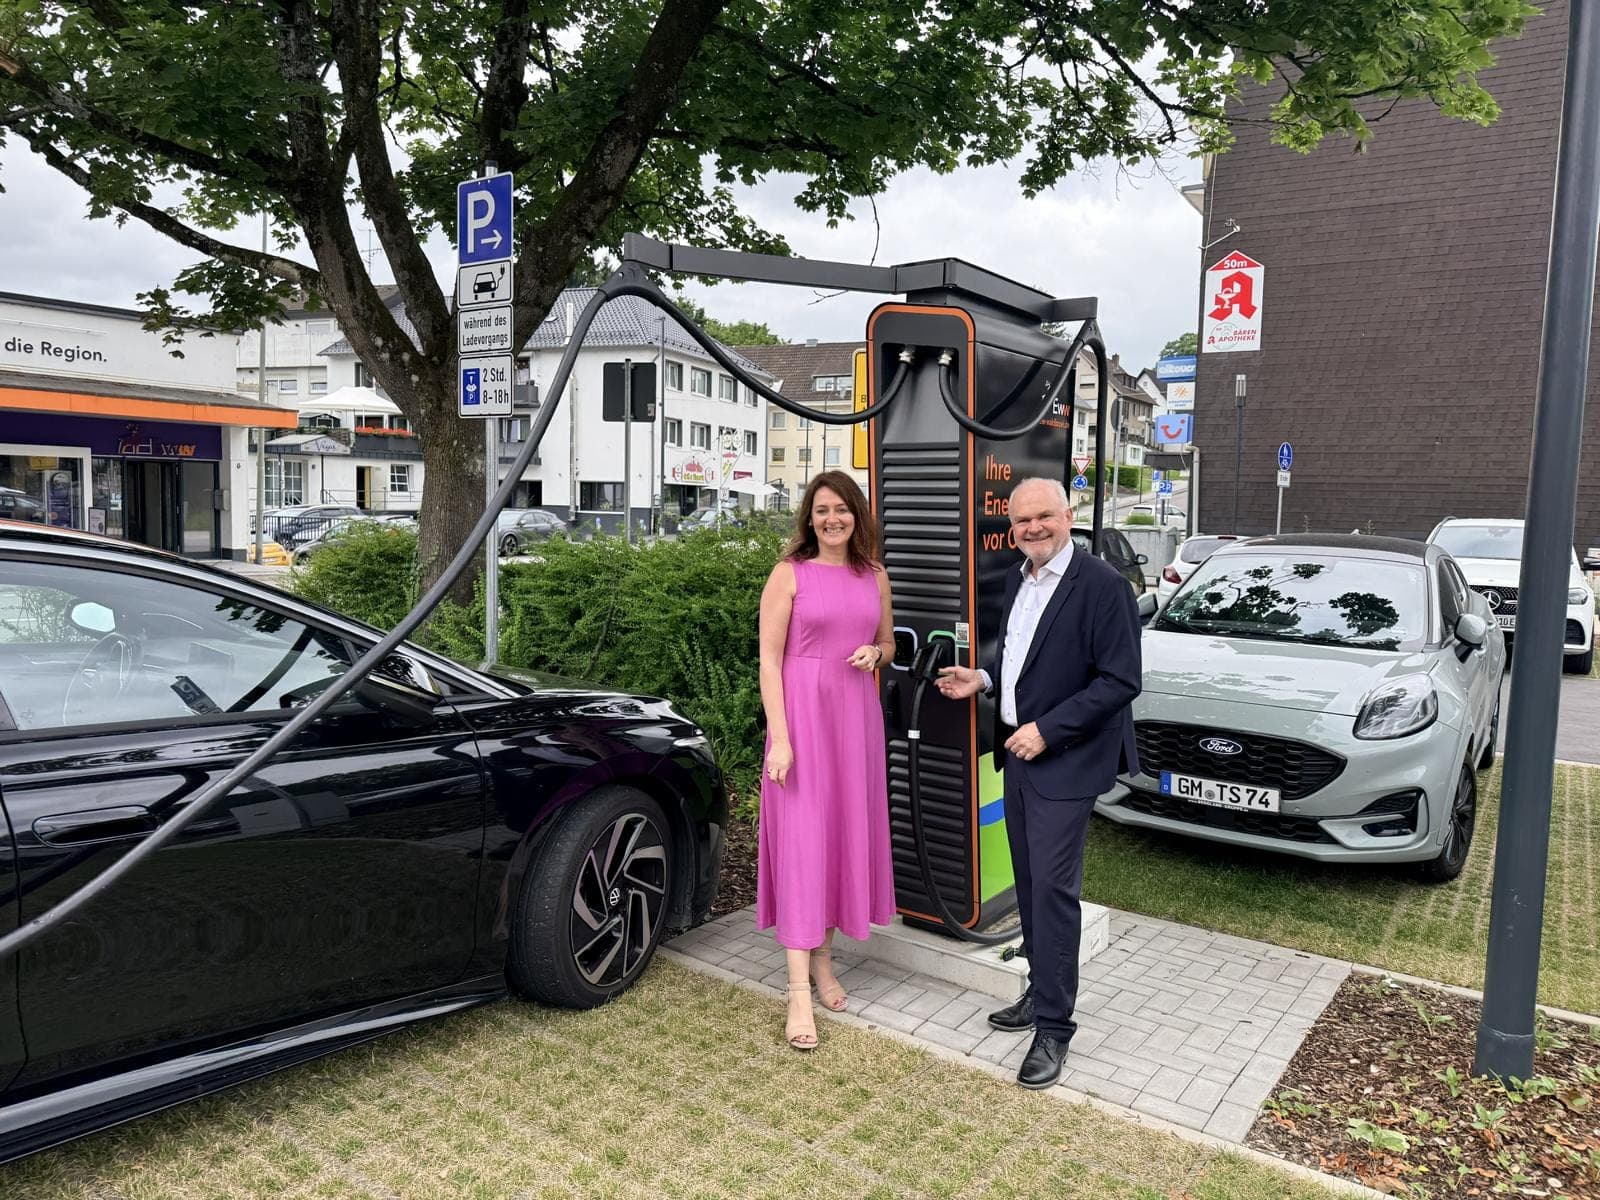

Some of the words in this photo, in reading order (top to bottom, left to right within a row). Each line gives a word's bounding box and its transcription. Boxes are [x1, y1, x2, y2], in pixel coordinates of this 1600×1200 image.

[467, 190, 495, 253] P
[1223, 259, 1248, 269] 50m
[463, 315, 492, 329] während
[495, 314, 507, 327] des
[462, 333, 509, 347] Ladevorgangs
[1218, 334, 1256, 343] APOTHEKE
[4, 336, 35, 354] die
[40, 340, 108, 362] Region.
[482, 367, 488, 383] 2
[490, 367, 507, 382] Std.
[985, 454, 1012, 481] Ihre
[984, 491, 1009, 516] Ene
[982, 533, 1005, 551] vor
[1206, 740, 1235, 753] Ford
[1178, 777, 1202, 798] GM
[1215, 784, 1241, 804] TS
[1245, 788, 1270, 809] 74
